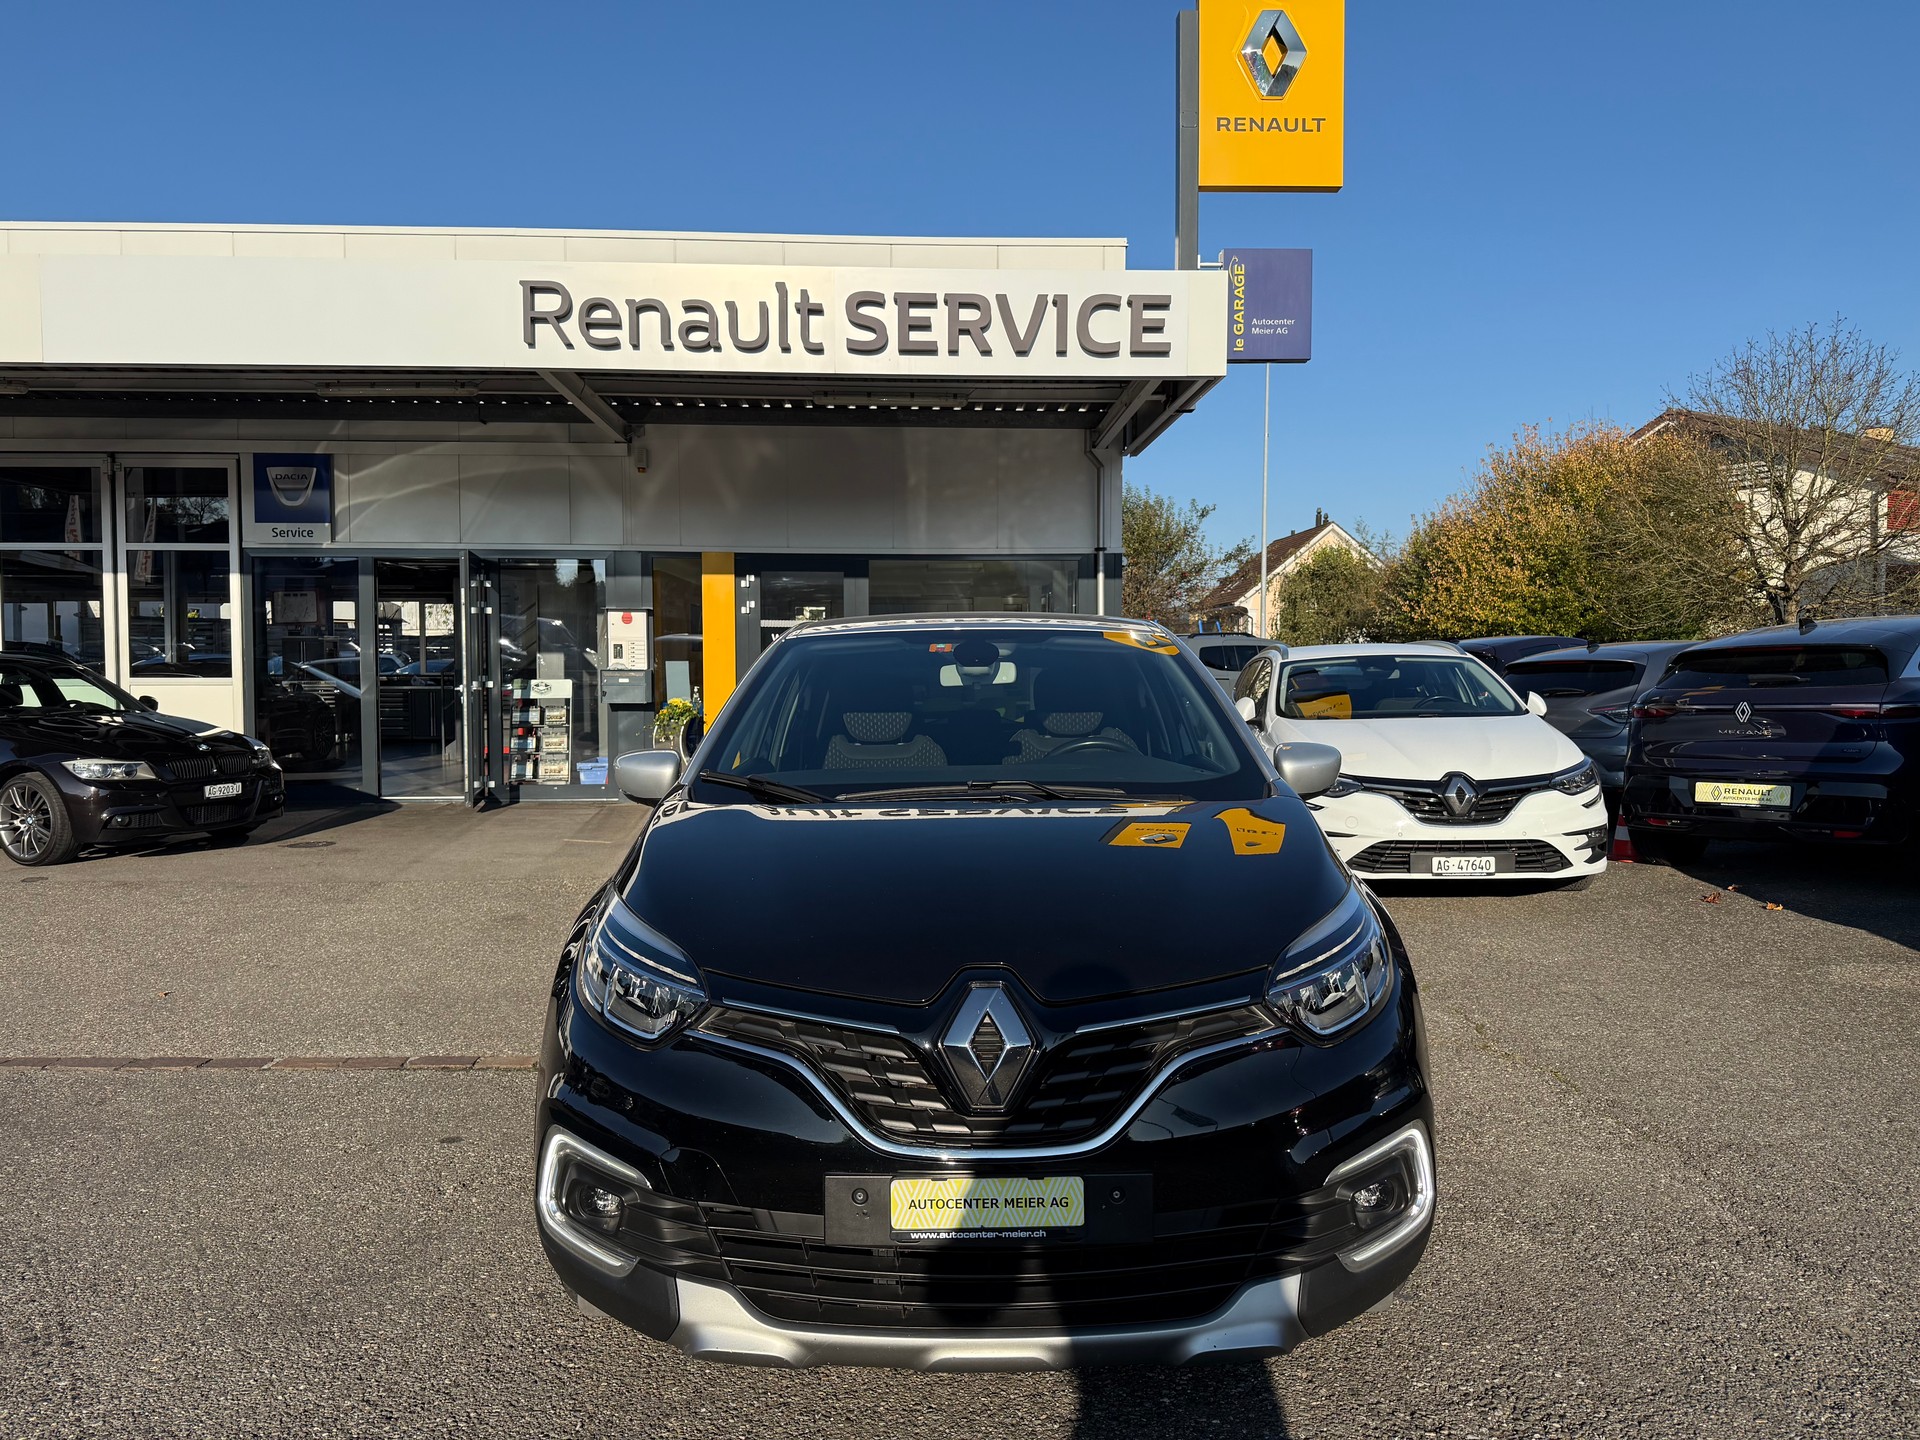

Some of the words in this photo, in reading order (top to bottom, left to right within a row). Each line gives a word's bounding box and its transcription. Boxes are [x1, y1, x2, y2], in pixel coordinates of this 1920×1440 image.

[1216, 117, 1326, 133] RENAULT
[1233, 263, 1245, 336] GARAGE
[519, 280, 825, 355] Renault
[845, 290, 1172, 358] SERVICE
[1251, 327, 1274, 335] Meier
[1275, 327, 1288, 335] AG
[1233, 338, 1244, 352] le
[271, 527, 314, 538] Service
[1724, 787, 1773, 796] RENAULT
[908, 1198, 999, 1210] AUTOCENTER
[1004, 1197, 1046, 1209] MEIER
[1050, 1196, 1069, 1208] AG
[910, 1230, 1047, 1239] www.autocenter-meier.ch
